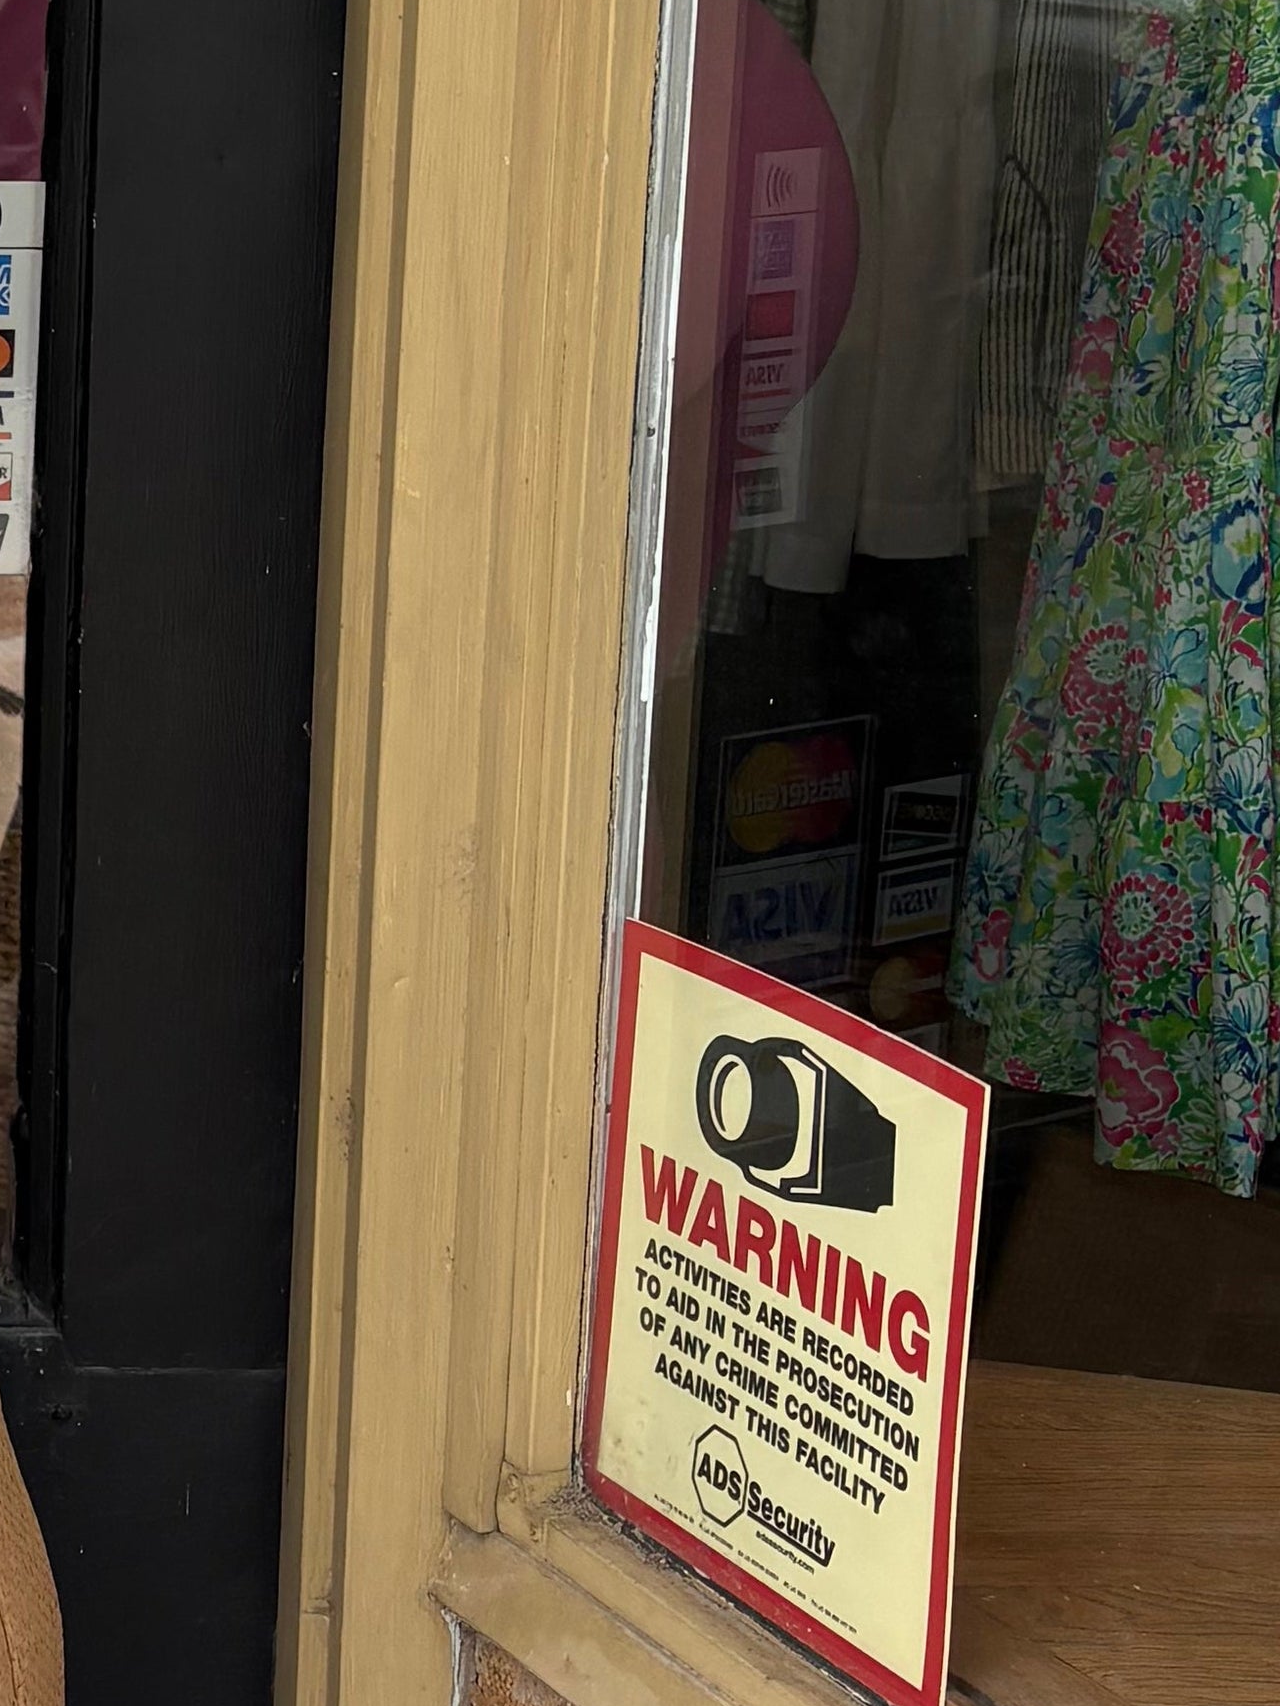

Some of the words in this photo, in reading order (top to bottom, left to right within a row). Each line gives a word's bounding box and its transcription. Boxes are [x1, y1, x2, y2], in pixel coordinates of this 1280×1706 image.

[640, 1143, 930, 1383] WARNING
[643, 1238, 752, 1316] ACTIVITIES
[756, 1301, 797, 1344] ARE
[802, 1326, 915, 1417] RECORDED
[635, 1266, 662, 1301] TO
[665, 1286, 700, 1322] AID
[705, 1307, 727, 1339] IN
[732, 1322, 771, 1366] THE
[776, 1349, 920, 1462] PROSECUTION
[639, 1306, 666, 1337] OF
[669, 1325, 712, 1365] ANY
[715, 1351, 780, 1409] CRIME
[784, 1394, 909, 1492] COMMITTED
[654, 1353, 740, 1421] AGAINST
[745, 1405, 791, 1454] THIS
[795, 1438, 887, 1515] FACILITY
[697, 1452, 743, 1502] ADS
[747, 1481, 836, 1565] Security
